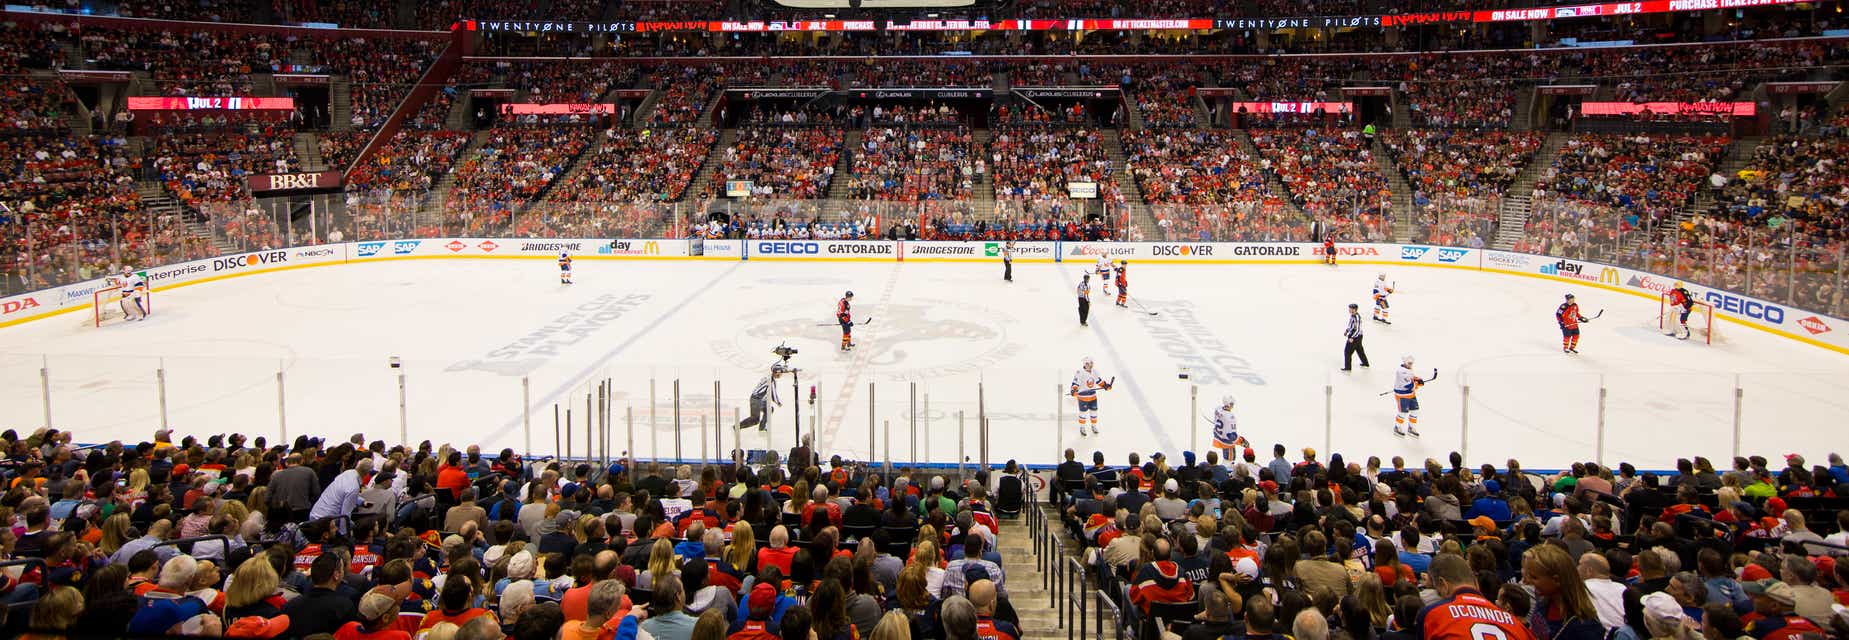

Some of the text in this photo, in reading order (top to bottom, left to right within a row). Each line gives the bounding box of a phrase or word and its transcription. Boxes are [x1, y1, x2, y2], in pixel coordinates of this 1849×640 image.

[1614, 3, 1641, 13] JUL 2
[1669, 0, 1718, 11] PURCHASE
[1491, 9, 1549, 21] ON SALE NOW
[215, 98, 221, 108] 2
[270, 172, 321, 190] BB&T
[521, 242, 582, 251] BRIDGESNE
[598, 240, 630, 254] all day
[759, 242, 819, 254] GEICO
[828, 244, 892, 254] GATORADE
[912, 245, 975, 255] BRIDGESTONE
[988, 245, 1050, 255] enerprise
[1152, 245, 1213, 256] DISCOVER
[1234, 246, 1300, 256] GATORADE
[1313, 247, 1379, 256] HNDA
[213, 251, 287, 272] DISCOVER
[1539, 259, 1583, 275] all day
[146, 264, 207, 282] nterprise
[1705, 291, 1784, 325] GEICO
[1214, 419, 1224, 436] 2
[664, 506, 682, 515] ELSON
[1448, 604, 1514, 625] OCONNOR
